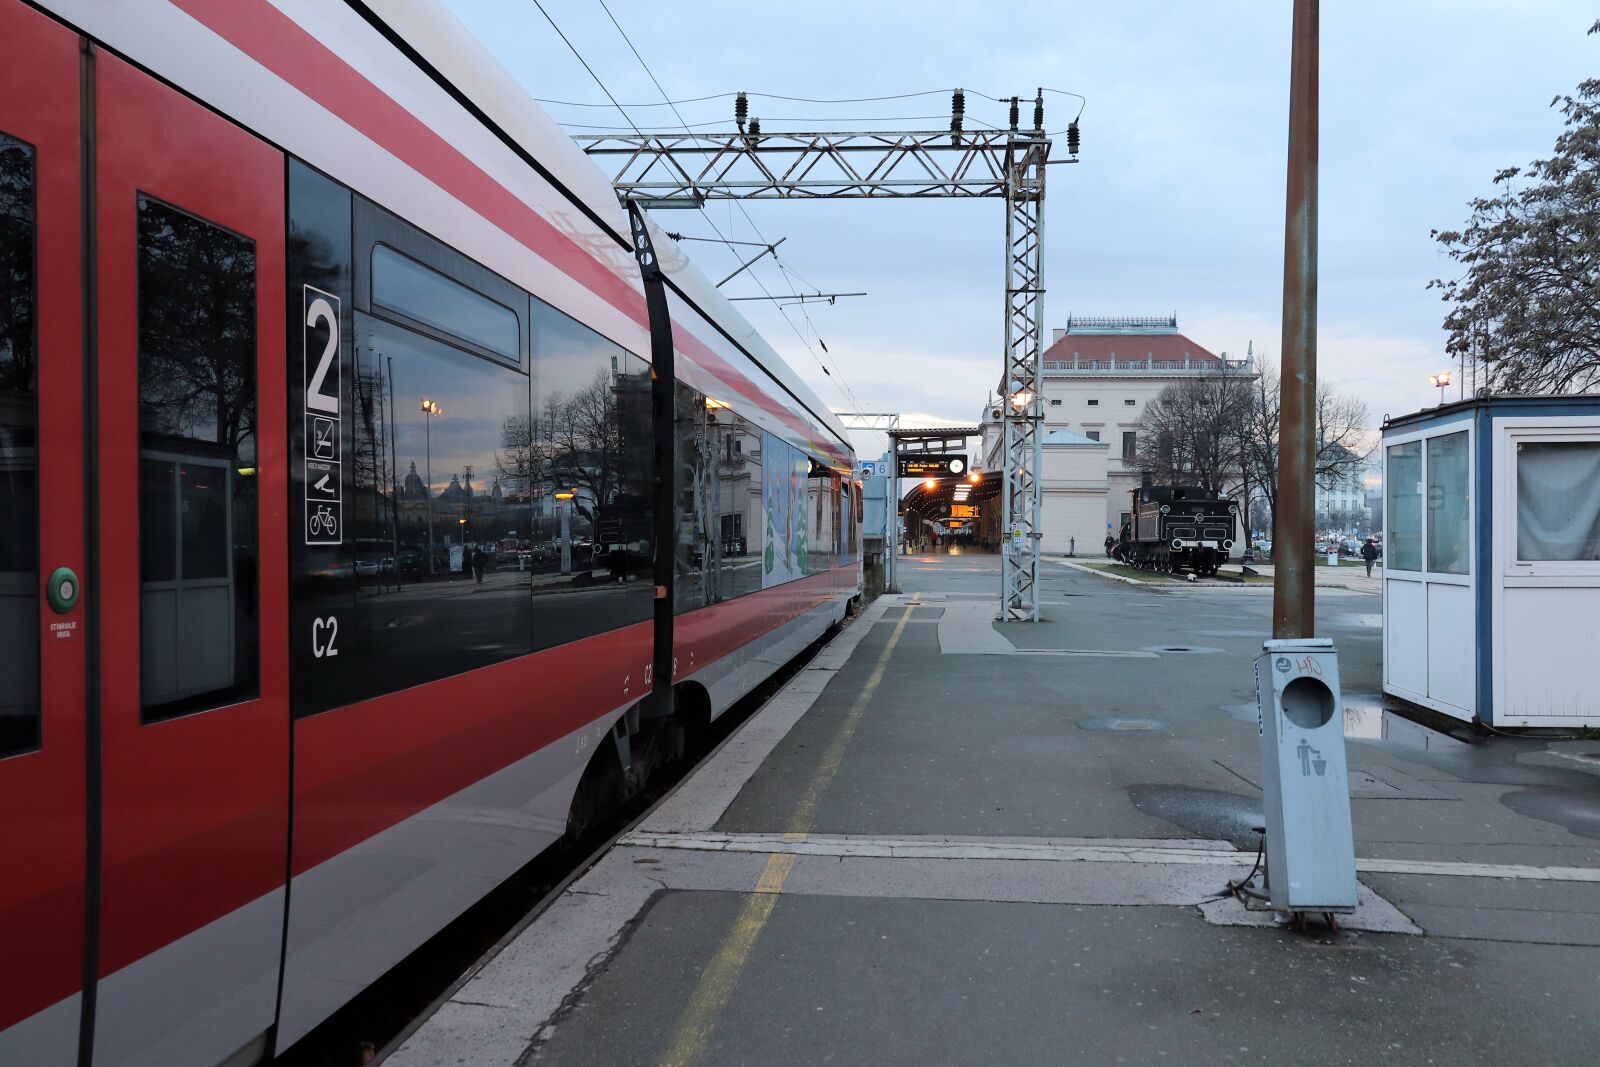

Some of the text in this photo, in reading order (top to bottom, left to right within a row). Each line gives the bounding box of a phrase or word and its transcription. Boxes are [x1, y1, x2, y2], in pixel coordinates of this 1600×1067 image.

[307, 298, 338, 414] 2
[879, 464, 886, 474] 6
[312, 616, 338, 658] C2
[644, 664, 652, 685] C2
